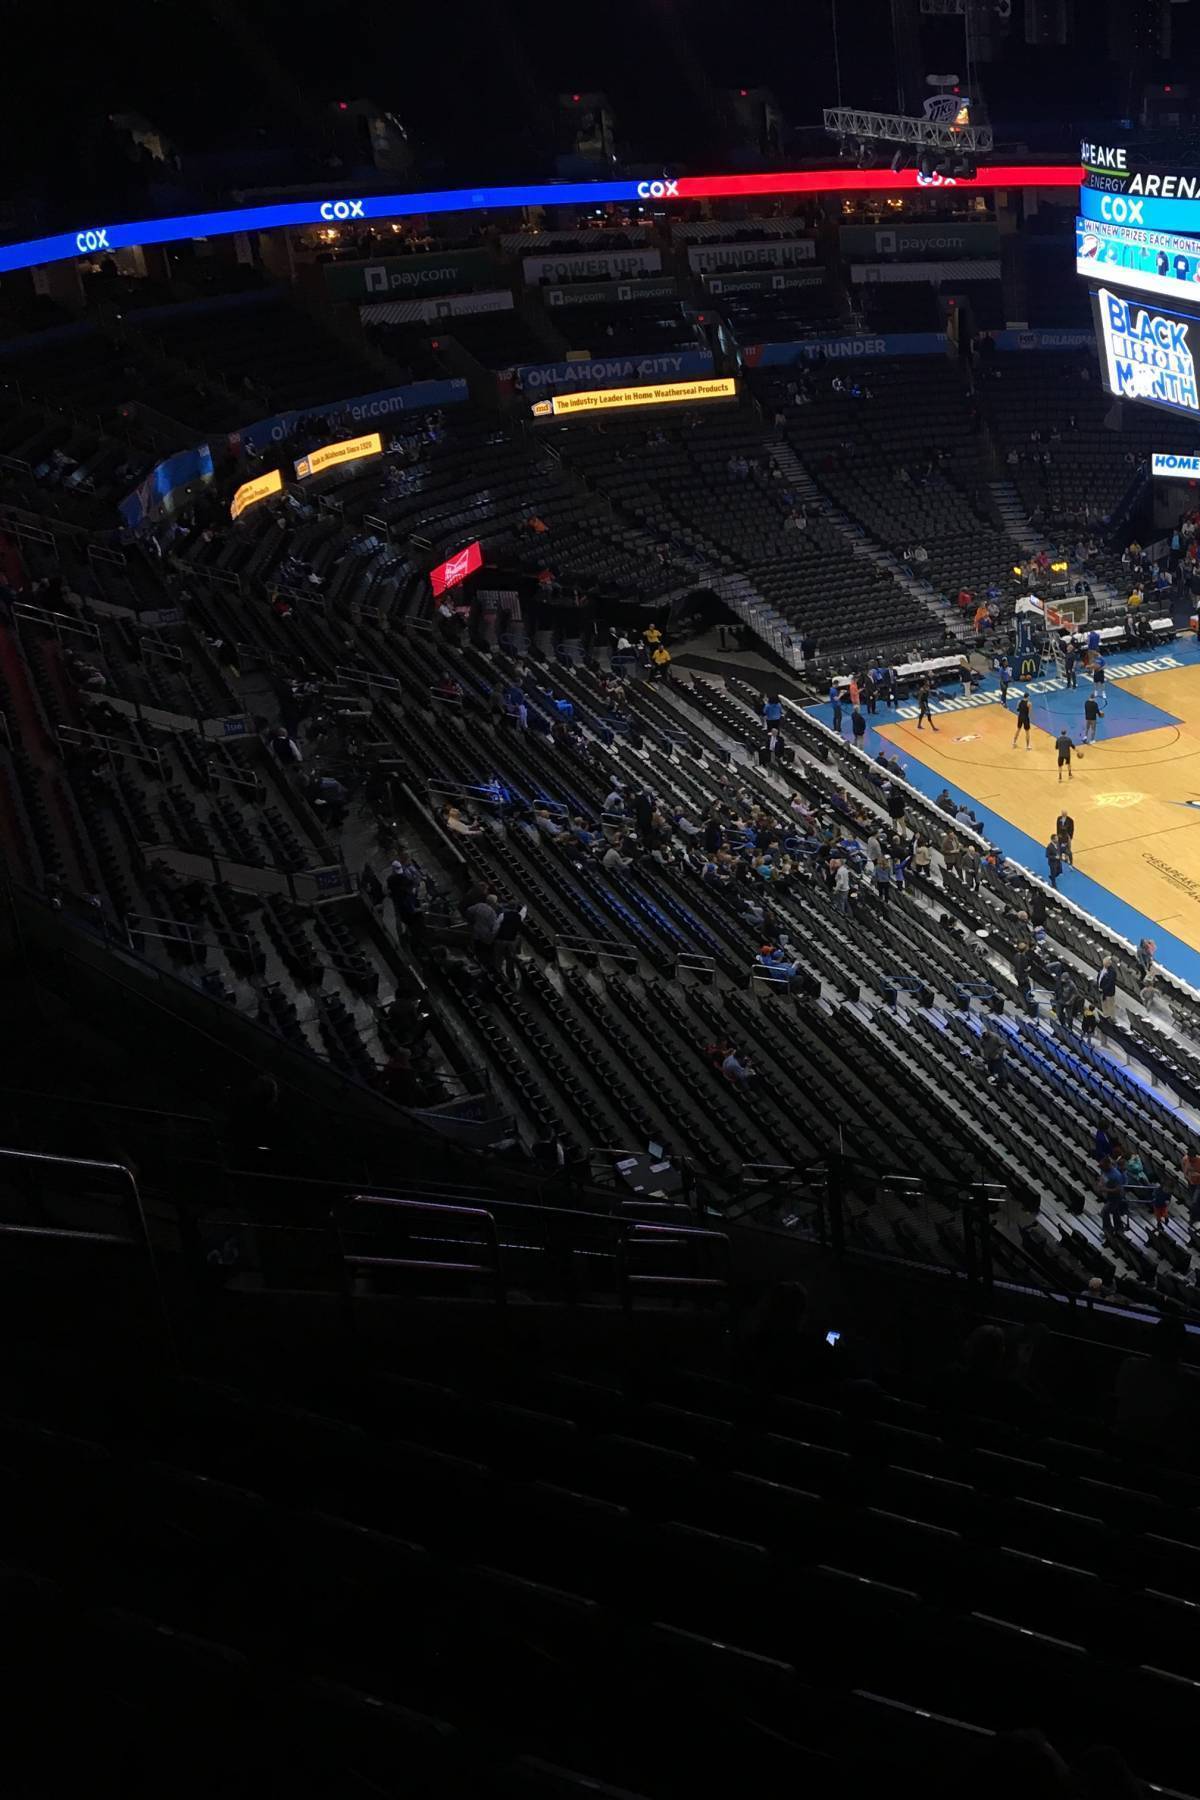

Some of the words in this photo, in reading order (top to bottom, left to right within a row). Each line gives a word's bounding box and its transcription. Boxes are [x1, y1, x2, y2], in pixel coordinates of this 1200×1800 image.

[637, 180, 679, 198] COX
[1090, 177, 1127, 192] ENERGY
[320, 200, 366, 221] COX
[1101, 196, 1144, 224] COX
[76, 229, 109, 253] COX
[1085, 219, 1100, 232] WIN
[1102, 224, 1118, 236] NEW
[1121, 228, 1147, 242] PRIZES
[1149, 234, 1170, 247] EACH
[1107, 294, 1188, 356] BLACK
[804, 339, 887, 360] THUNDER
[1112, 333, 1193, 377] HISTORY
[527, 361, 633, 387] OKLAHOMA
[641, 356, 683, 378] CITY
[1115, 359, 1197, 407] MNTH
[557, 400, 570, 409] The
[570, 397, 598, 408] Industry
[599, 394, 623, 403] Leader
[633, 391, 653, 400] Home
[655, 386, 697, 398] Weatherseal
[698, 384, 729, 393] Products
